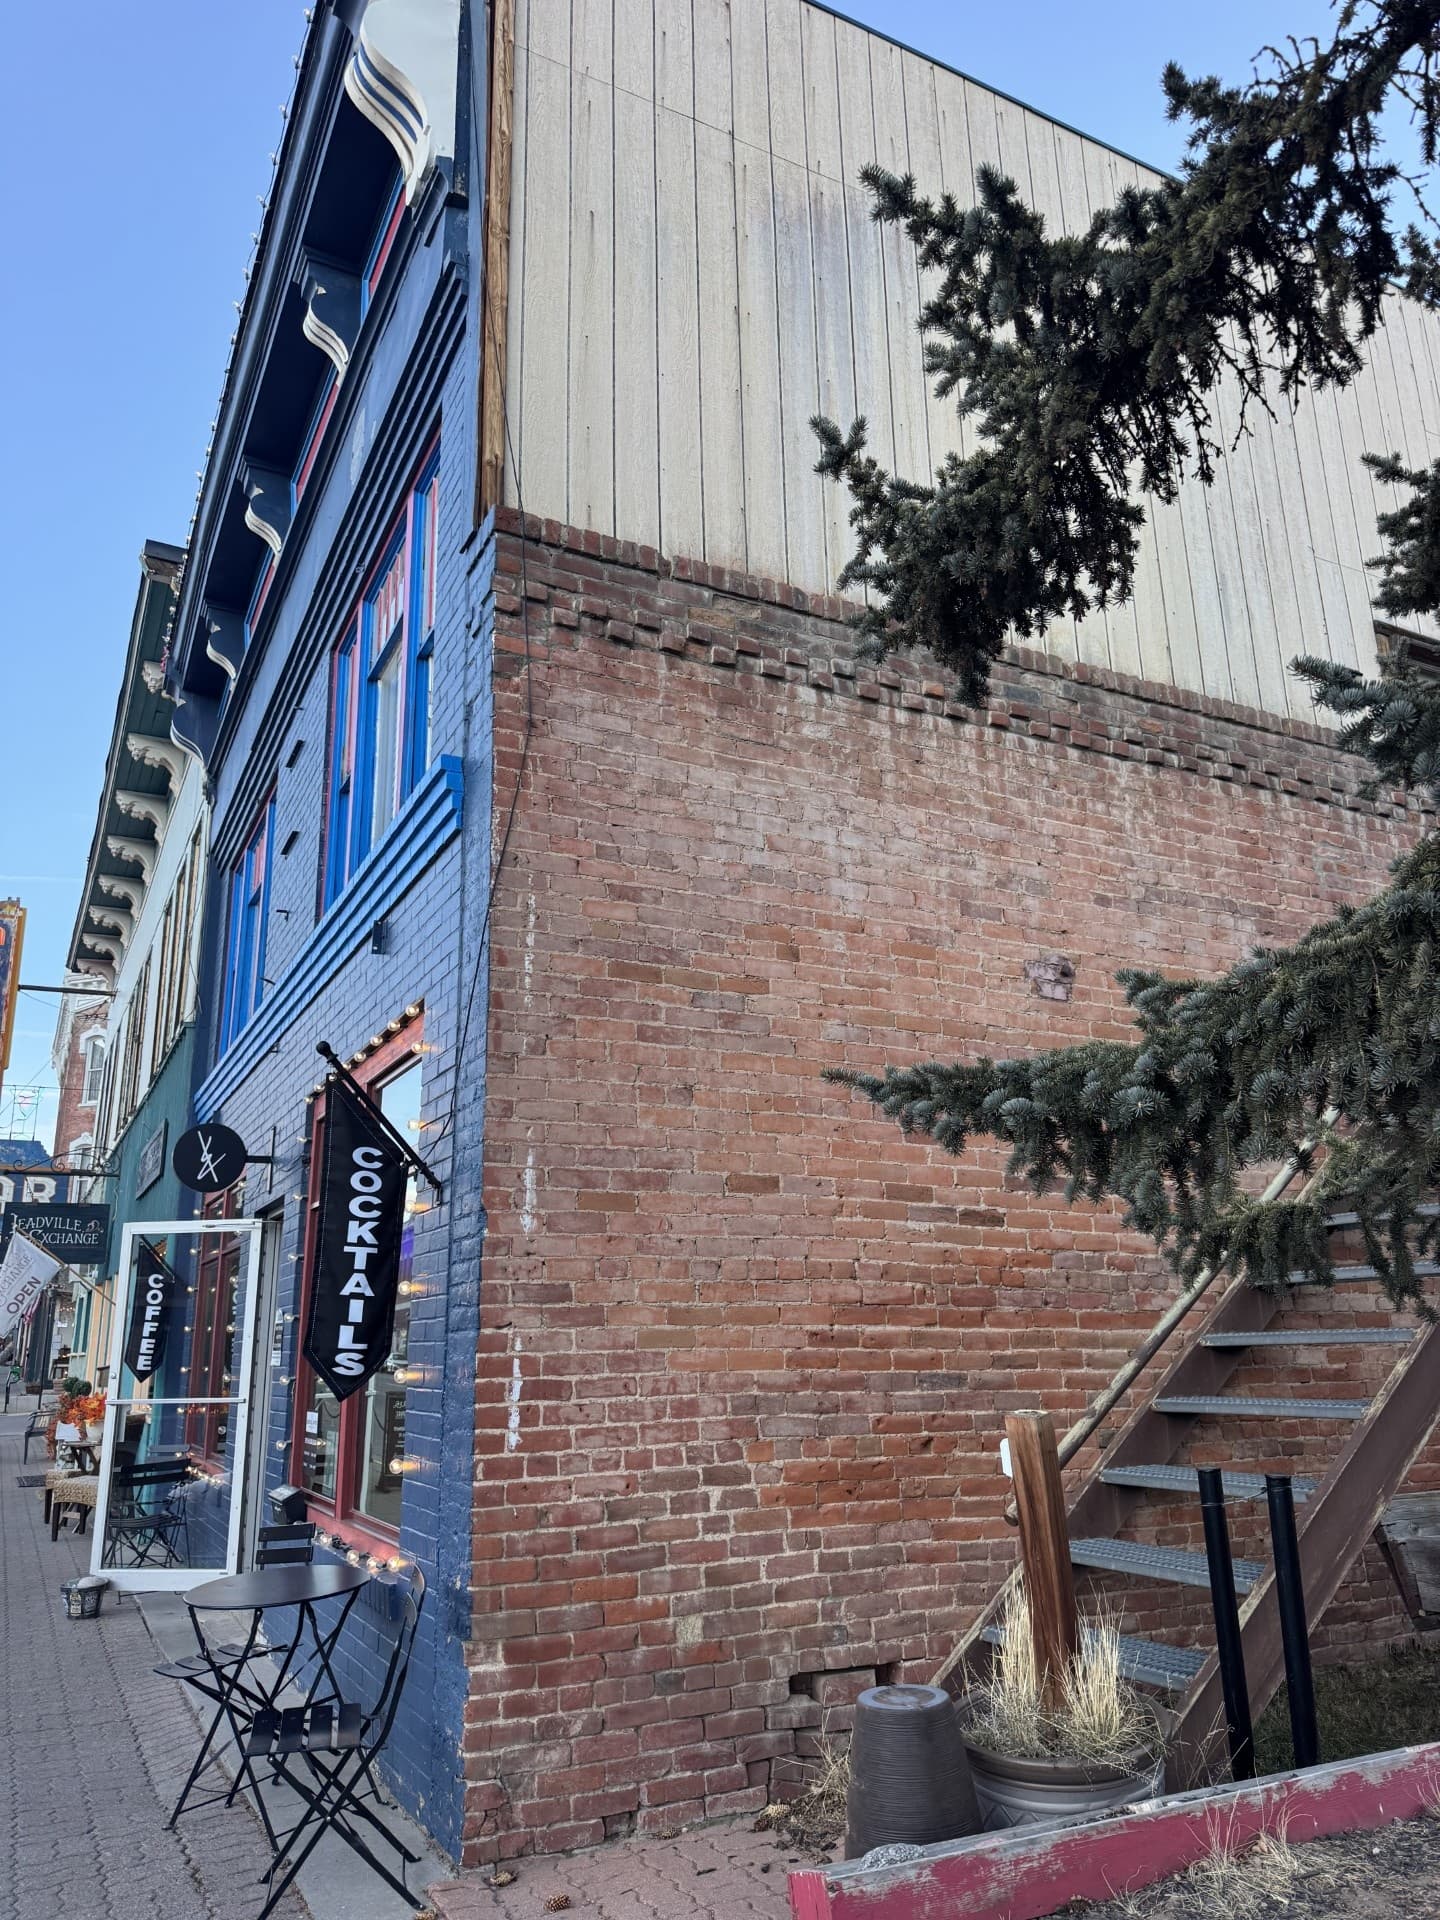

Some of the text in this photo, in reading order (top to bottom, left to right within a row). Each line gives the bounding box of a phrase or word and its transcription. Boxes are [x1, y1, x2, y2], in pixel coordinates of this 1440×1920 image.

[10, 1213, 83, 1234] LEADVILLE
[7, 1276, 41, 1314] OPEN
[331, 1146, 384, 1377] COCKTAILS
[137, 1273, 165, 1371] COFFEE
